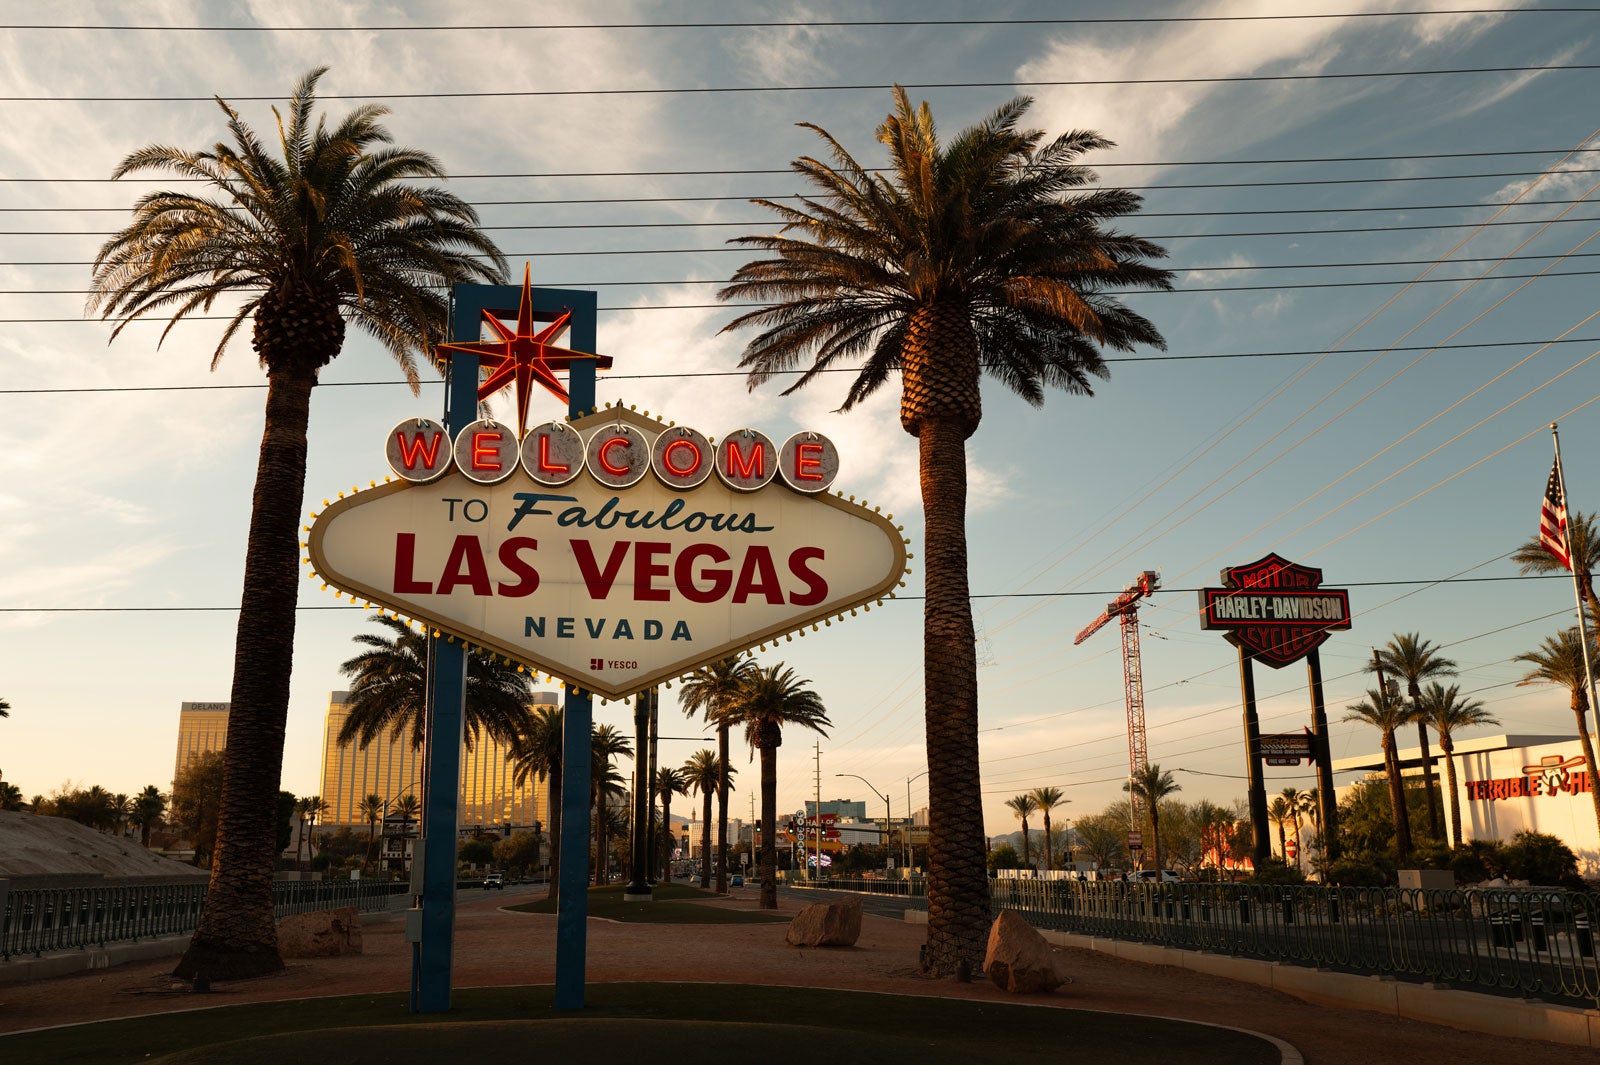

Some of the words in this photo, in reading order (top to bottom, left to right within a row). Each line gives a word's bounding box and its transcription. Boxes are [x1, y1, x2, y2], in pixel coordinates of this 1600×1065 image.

[396, 432, 824, 481] WELCOME
[442, 498, 488, 522] TO
[507, 493, 774, 533] Fabulous
[393, 533, 540, 598] LAS
[569, 539, 829, 606] VEGAS
[1242, 563, 1310, 589] MOTOR
[1214, 596, 1342, 619] HARLEY-DAVIDSON
[524, 616, 693, 641] NEVADA
[1247, 627, 1314, 656] CYCLES
[607, 660, 638, 670] YESCO
[1465, 776, 1542, 801] TERRIBLE
